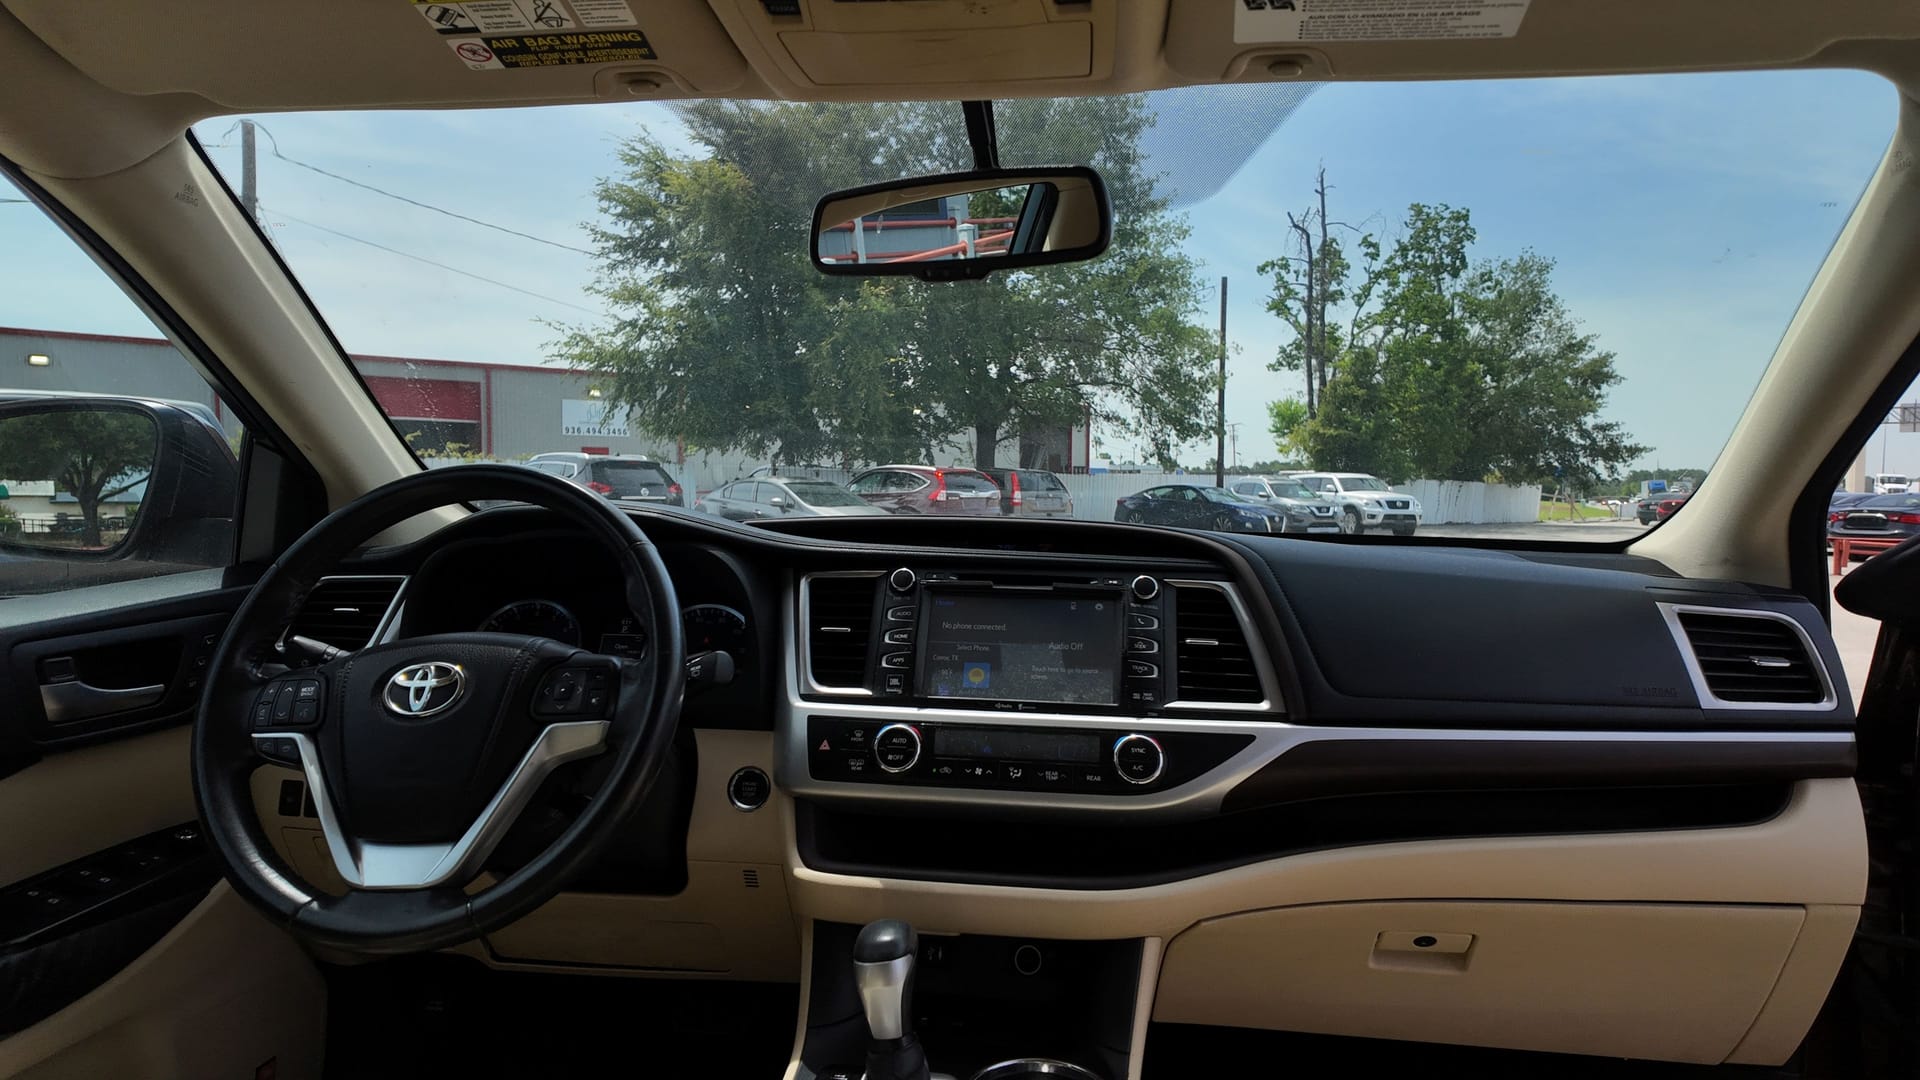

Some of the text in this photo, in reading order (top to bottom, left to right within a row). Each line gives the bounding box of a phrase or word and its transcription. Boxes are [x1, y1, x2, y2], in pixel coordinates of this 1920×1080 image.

[491, 31, 642, 49] AIR BAG WARNING
[942, 621, 952, 630] No
[953, 622, 973, 632] phone
[1048, 641, 1084, 651] Audio Off
